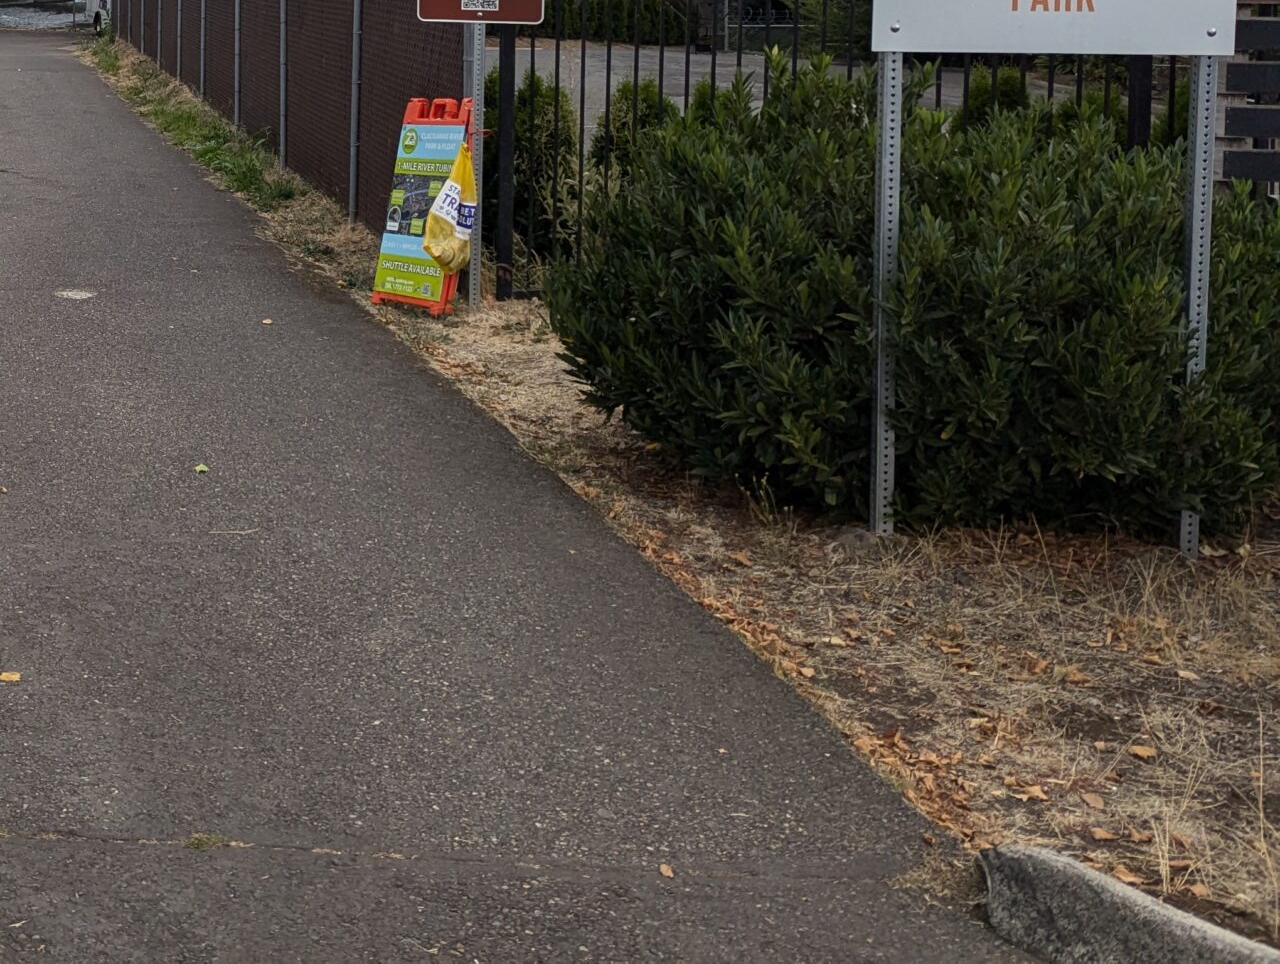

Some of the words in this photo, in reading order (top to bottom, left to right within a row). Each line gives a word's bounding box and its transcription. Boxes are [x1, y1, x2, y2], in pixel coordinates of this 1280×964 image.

[398, 162, 417, 170] 1-MILE
[418, 163, 435, 171] RIVER
[382, 260, 408, 271] SHUTTLE
[408, 264, 441, 276] AVAILABLE
